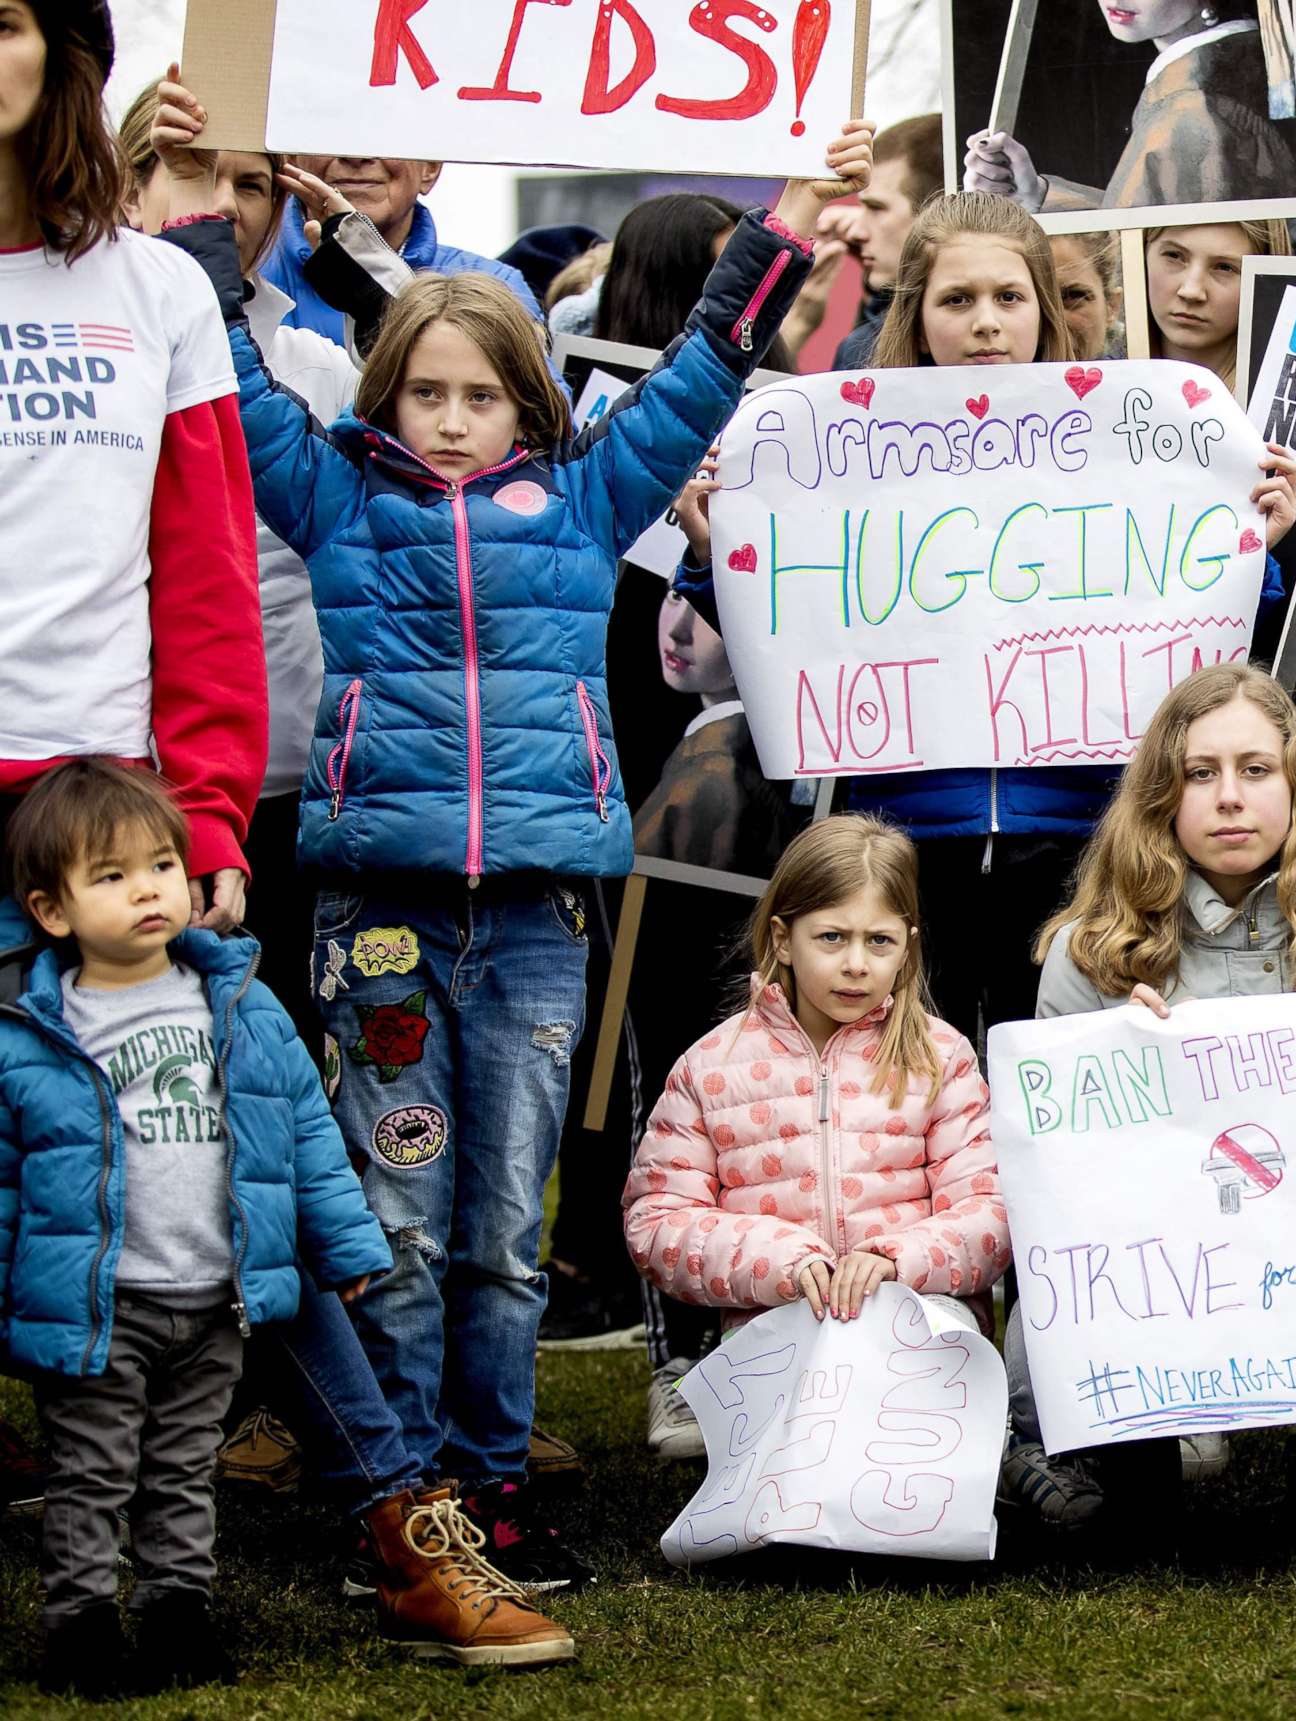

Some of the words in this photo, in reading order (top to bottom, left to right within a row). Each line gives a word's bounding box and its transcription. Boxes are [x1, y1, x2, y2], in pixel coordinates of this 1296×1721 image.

[369, 0, 831, 137] KIDS!
[0, 323, 48, 350] S
[0, 357, 116, 385] AND
[0, 391, 97, 421] ION
[51, 430, 67, 446] IN
[74, 430, 144, 451] AMERICA
[1112, 387, 1226, 467] for
[770, 501, 1240, 635] HUGGING
[797, 658, 940, 770] NOT
[984, 632, 1248, 763] KILLI
[137, 1105, 220, 1144] STATE
[1017, 1046, 1173, 1136] BAN
[1028, 1237, 1246, 1331] STRIVE
